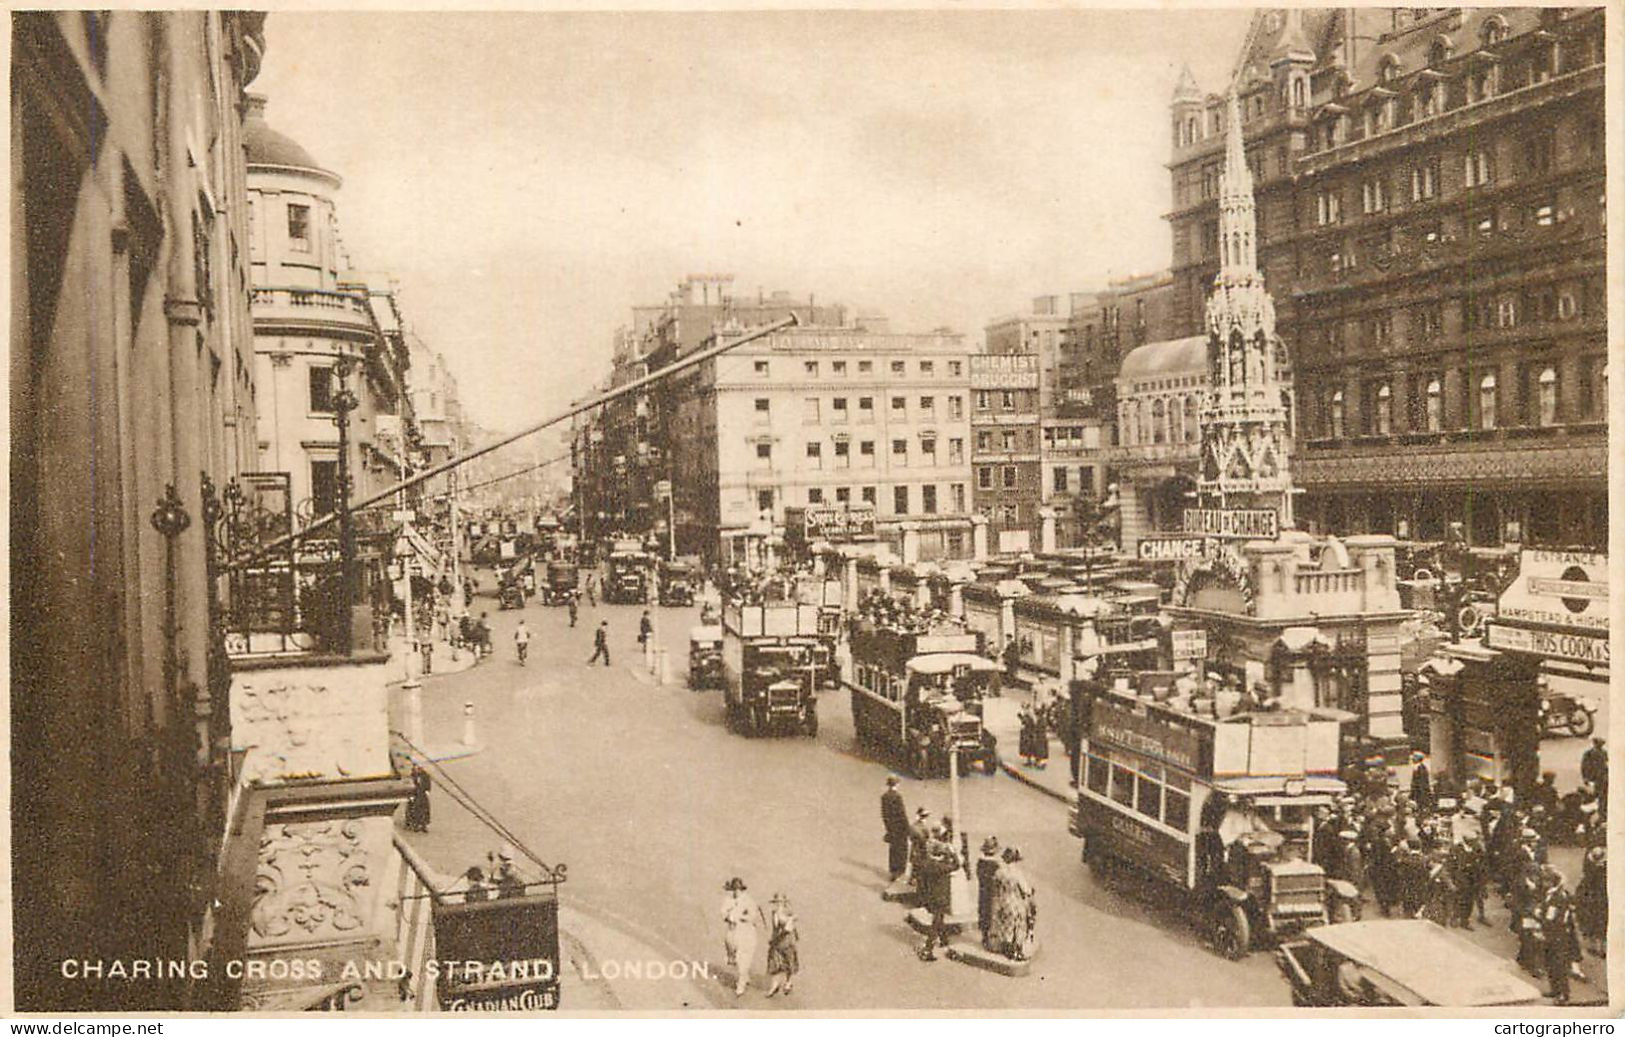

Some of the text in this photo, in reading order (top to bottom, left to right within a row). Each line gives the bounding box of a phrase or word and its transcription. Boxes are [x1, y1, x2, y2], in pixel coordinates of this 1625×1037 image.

[969, 355, 1036, 370] CHEMIST
[969, 373, 1038, 388] DRUGGIST
[1232, 511, 1274, 536] CHANGE
[1140, 540, 1202, 557] CHANGE
[1533, 553, 1596, 566] ENTRANCE
[1501, 608, 1561, 624] HAMPSTEAD
[1560, 636, 1595, 660] COOK
